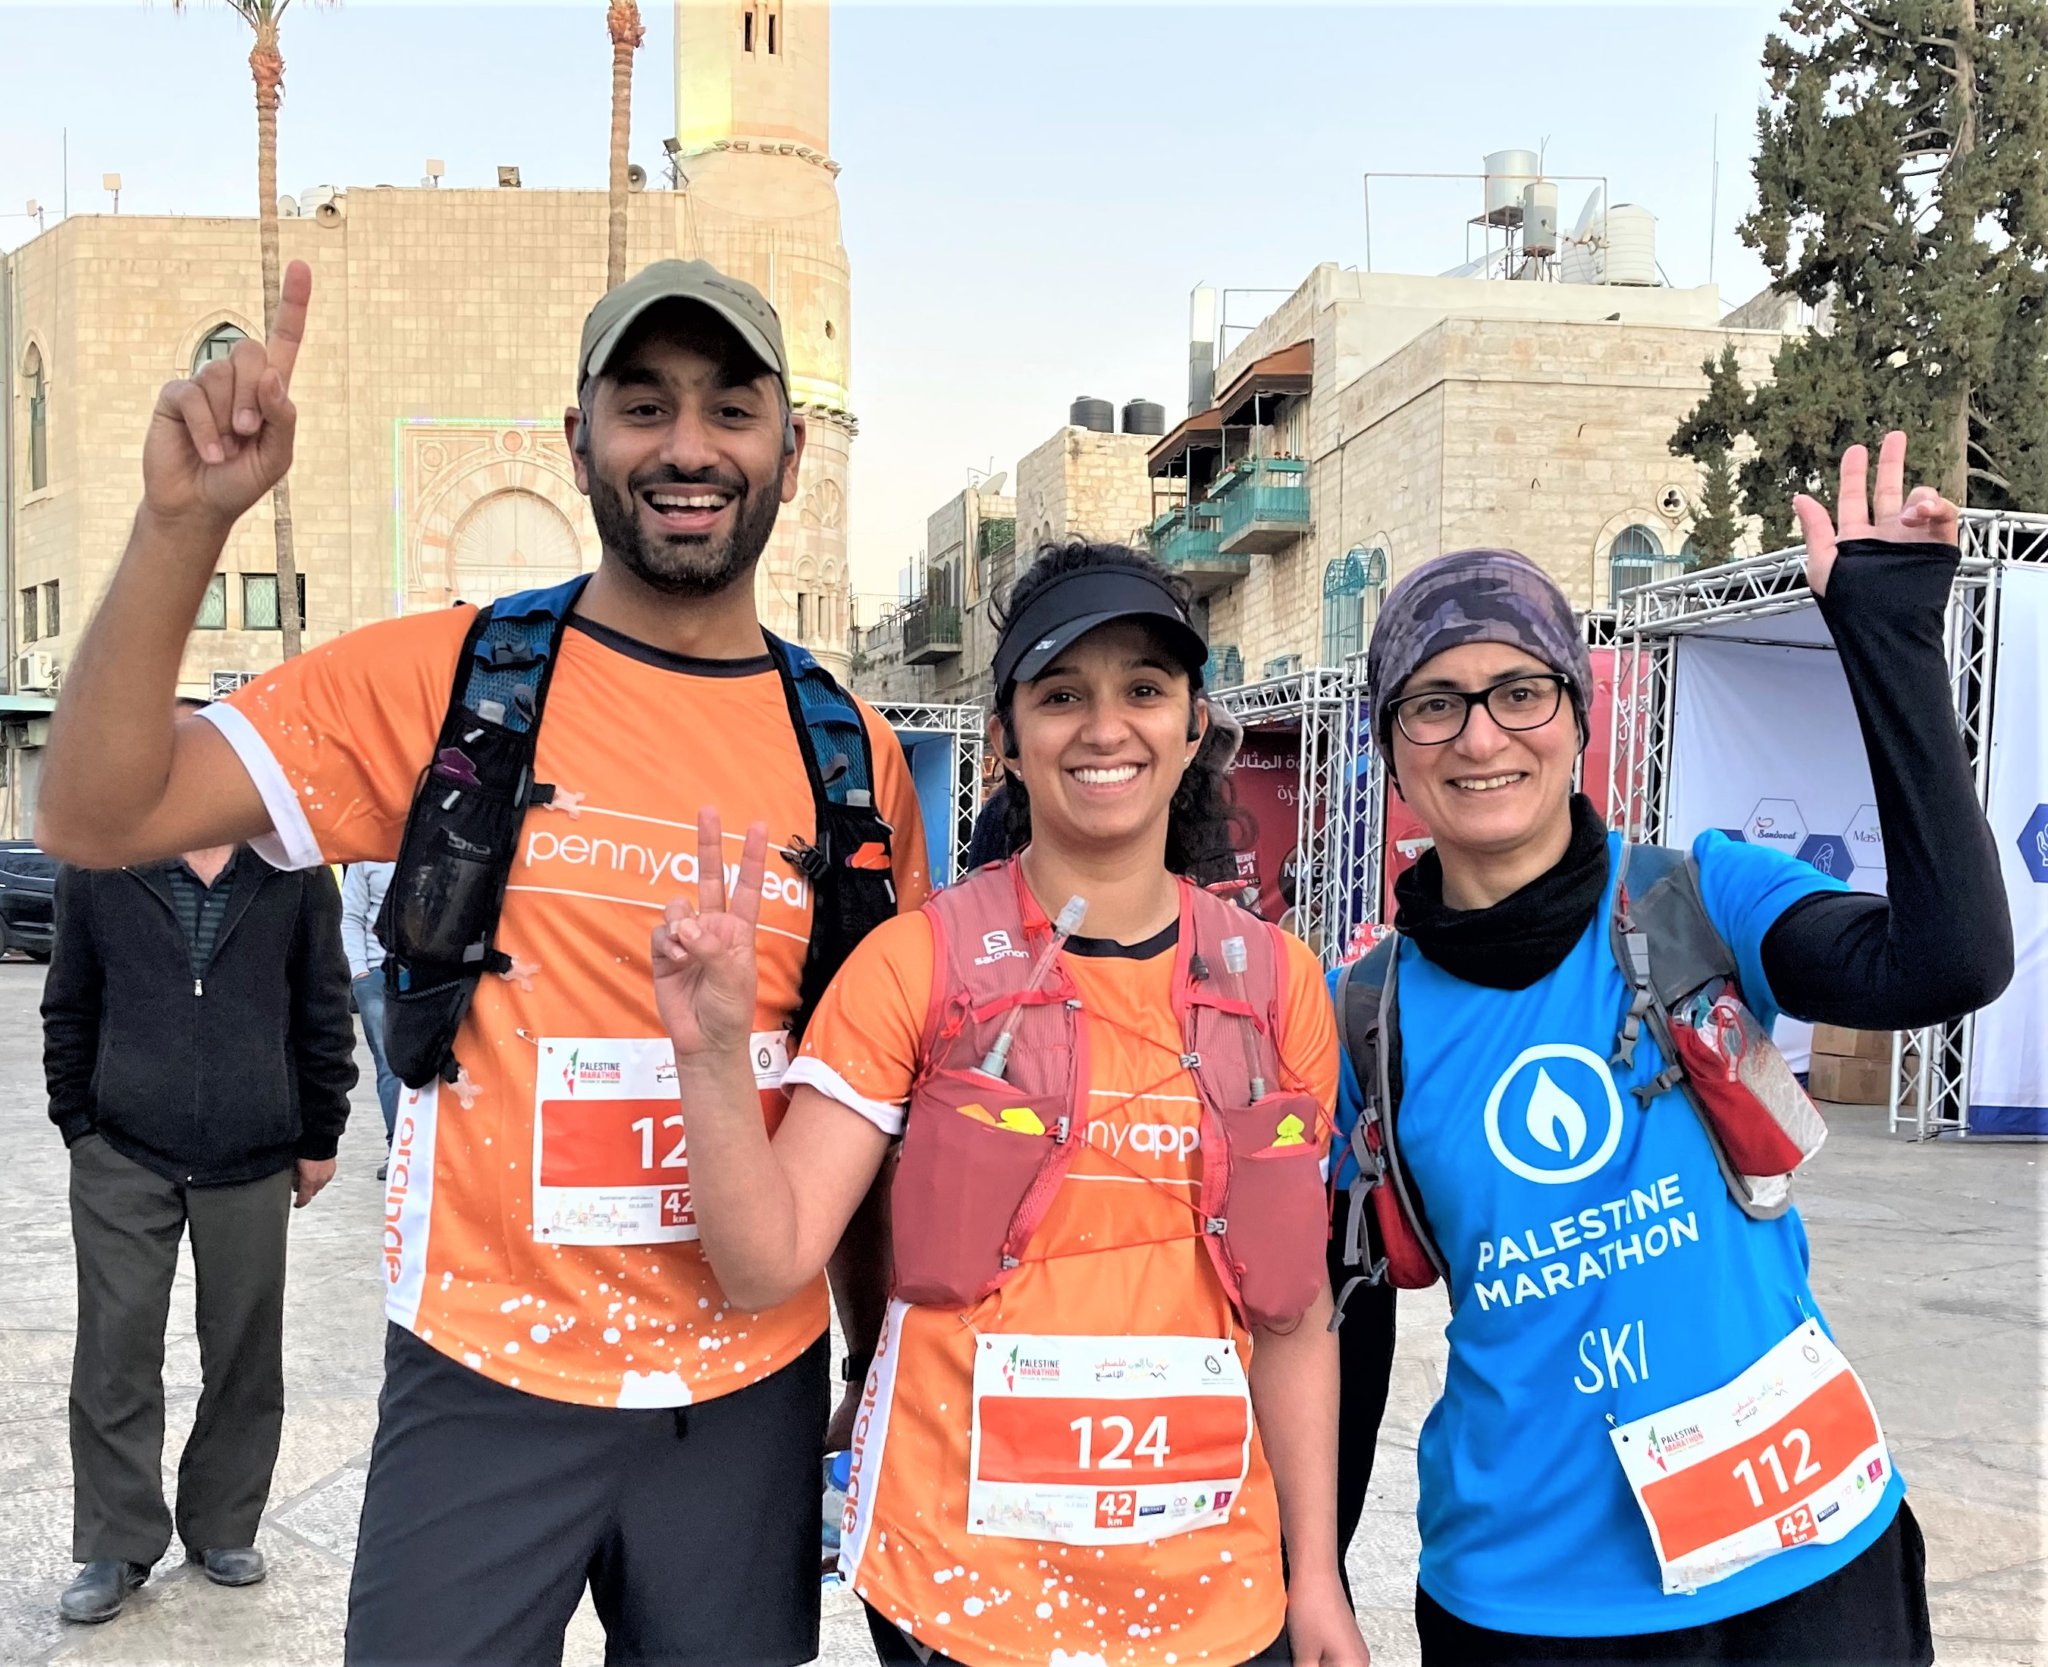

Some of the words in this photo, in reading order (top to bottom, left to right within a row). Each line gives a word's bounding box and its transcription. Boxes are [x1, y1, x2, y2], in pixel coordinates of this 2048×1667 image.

[525, 831, 808, 910] pennyaeal
[580, 1062, 620, 1071] PALESTINE
[631, 1115, 688, 1169] 12
[664, 1192, 693, 1213] 42
[673, 1215, 688, 1224] km
[1478, 1173, 1684, 1272] PALESTINE
[1474, 1211, 1699, 1311] MARATHON
[1020, 1359, 1060, 1368] PALESTINE
[1574, 1319, 1649, 1394] SKI
[1069, 1415, 1171, 1469] 124
[1660, 1424, 1701, 1446] PALESTINE
[1732, 1427, 1822, 1508] 112
[1098, 1493, 1133, 1517] 42
[1107, 1517, 1123, 1526] km
[1781, 1508, 1812, 1537] 42
[1792, 1532, 1808, 1544] km
